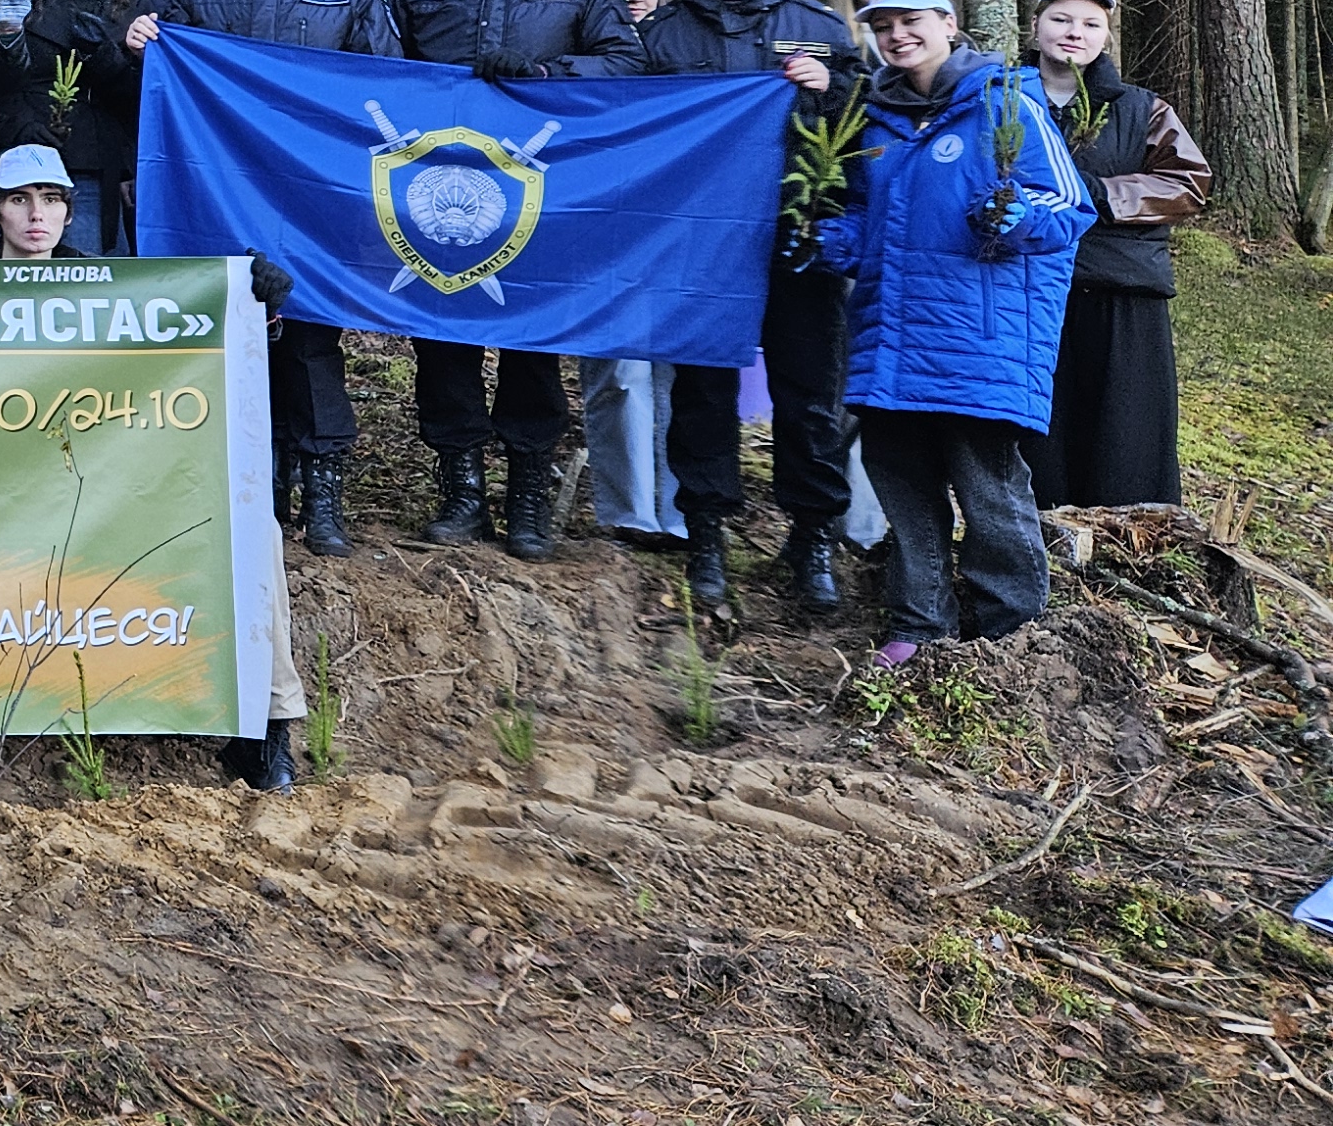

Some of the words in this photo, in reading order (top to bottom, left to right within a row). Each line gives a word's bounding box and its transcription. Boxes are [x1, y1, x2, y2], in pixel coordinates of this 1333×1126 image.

[3, 266, 113, 283] УСТАНОВА
[390, 231, 439, 279] СЛЕДЧЫ
[458, 242, 516, 284] КАМІТЭТ
